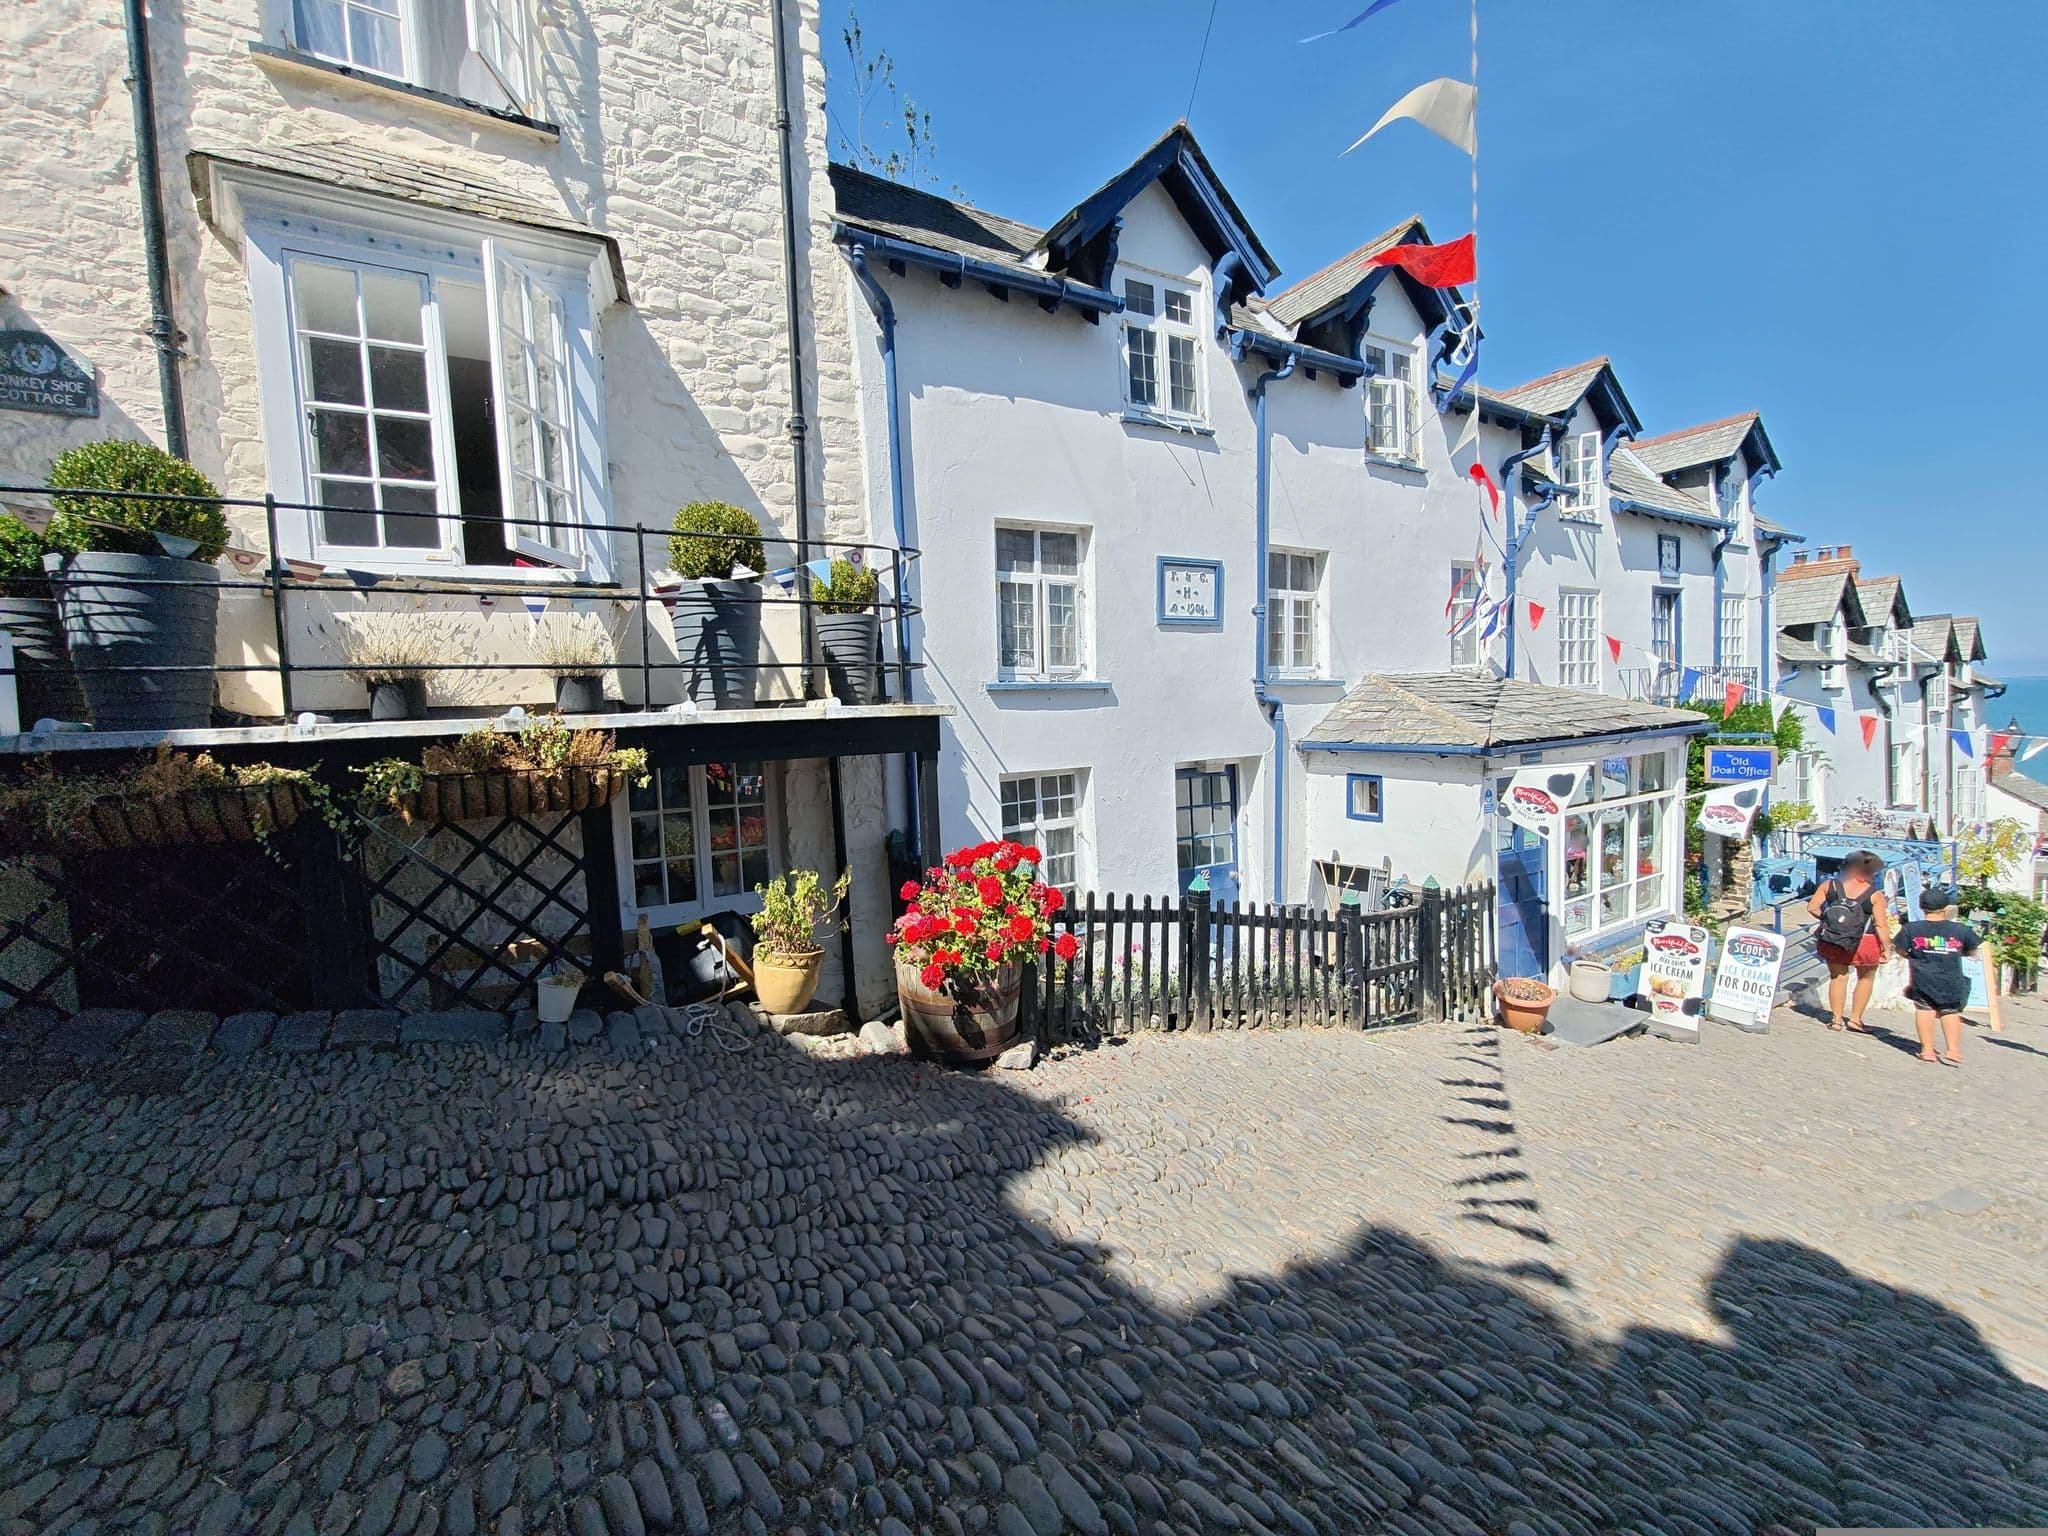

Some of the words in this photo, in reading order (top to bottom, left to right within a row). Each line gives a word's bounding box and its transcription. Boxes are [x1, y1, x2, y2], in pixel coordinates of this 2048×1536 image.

[0, 374, 48, 390] ONKEY
[50, 379, 86, 394] SHOE
[0, 388, 76, 406] COTTAGE
[1712, 766, 1735, 775] Post
[1738, 766, 1769, 776] Office
[1731, 758, 1749, 766] Old
[1650, 962, 1662, 974] ICE
[1666, 966, 1694, 980] CREAM
[1724, 965, 1738, 976] ICE
[1742, 968, 1772, 983] CREAM
[1718, 975, 1738, 990] FOR
[1742, 980, 1773, 998] DOGS
